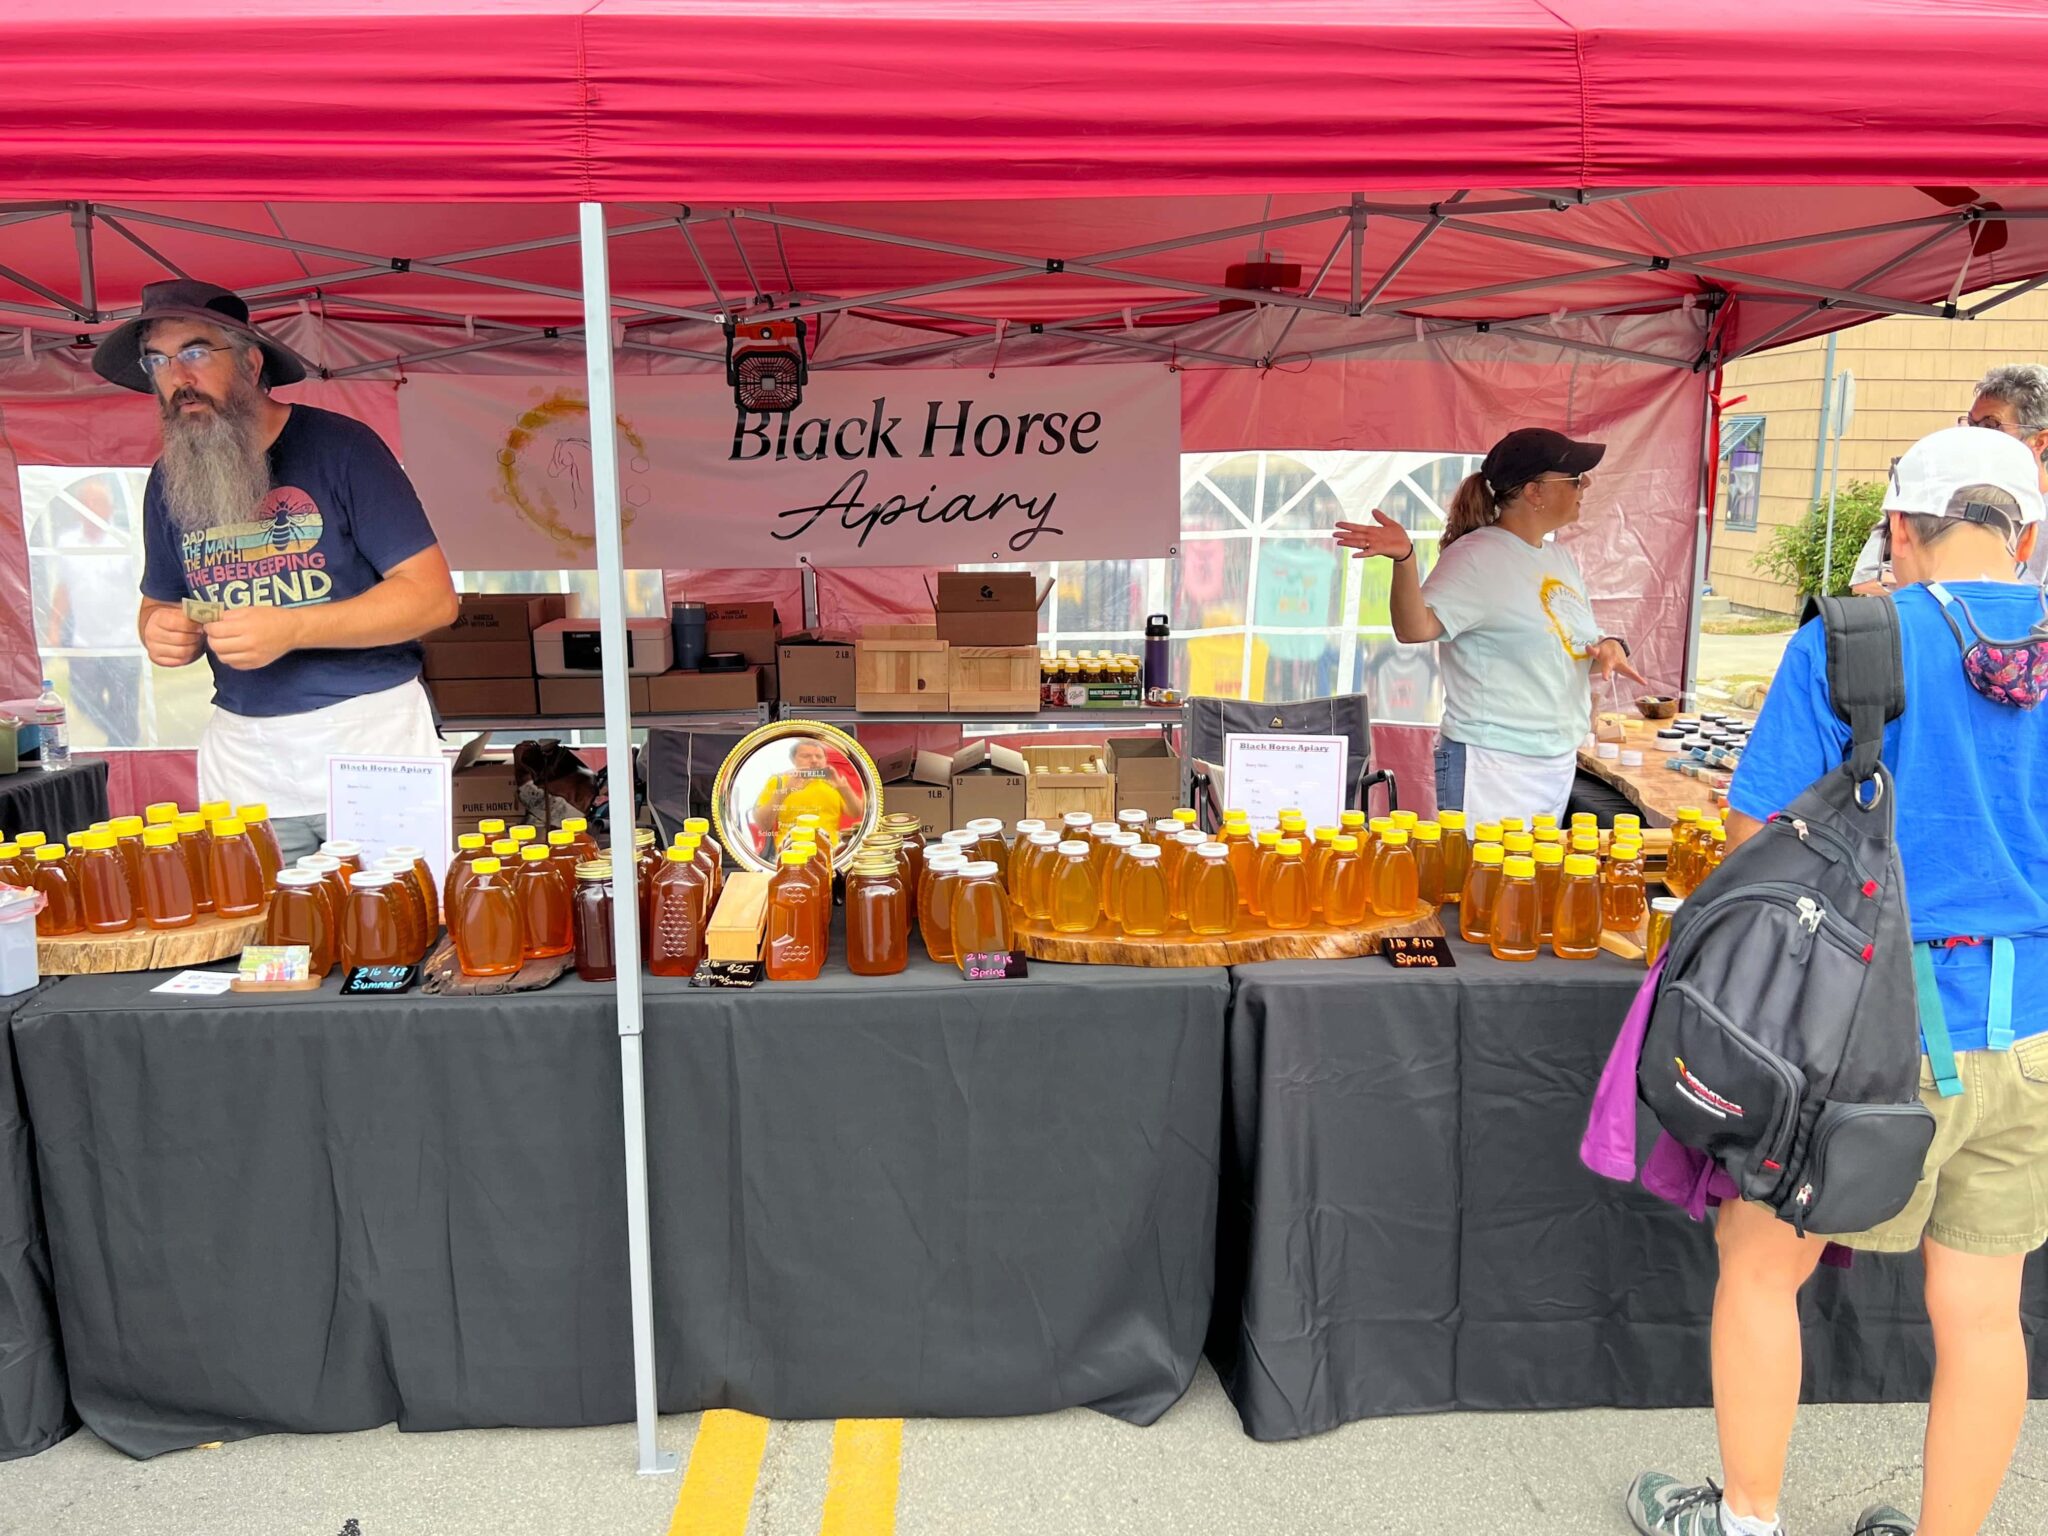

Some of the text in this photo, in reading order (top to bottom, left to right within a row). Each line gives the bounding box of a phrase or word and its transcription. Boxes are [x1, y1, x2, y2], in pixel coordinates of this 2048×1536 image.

[729, 397, 1102, 462] Black Horse
[770, 468, 1064, 552] Apiary
[182, 530, 205, 546] DAD
[182, 536, 236, 559] THE MAN
[184, 550, 242, 572] THE MYTH
[187, 552, 326, 588] THE BEEKEEPING
[783, 650, 791, 658] 12
[836, 650, 840, 659] 2
[799, 695, 837, 703] PURE HONEY
[1240, 742, 1329, 752] Black Horse Apiary
[340, 763, 432, 774] Black Horse Apiary
[956, 778, 963, 786] 12
[463, 802, 513, 812] PURE HONEY
[1412, 937, 1434, 948] $10
[967, 953, 975, 961] 2
[1395, 952, 1439, 966] Spring
[700, 958, 710, 967] 3
[727, 963, 754, 974] $25
[355, 967, 369, 979] 2
[969, 967, 1006, 978] Spring
[351, 979, 403, 989] Summer
